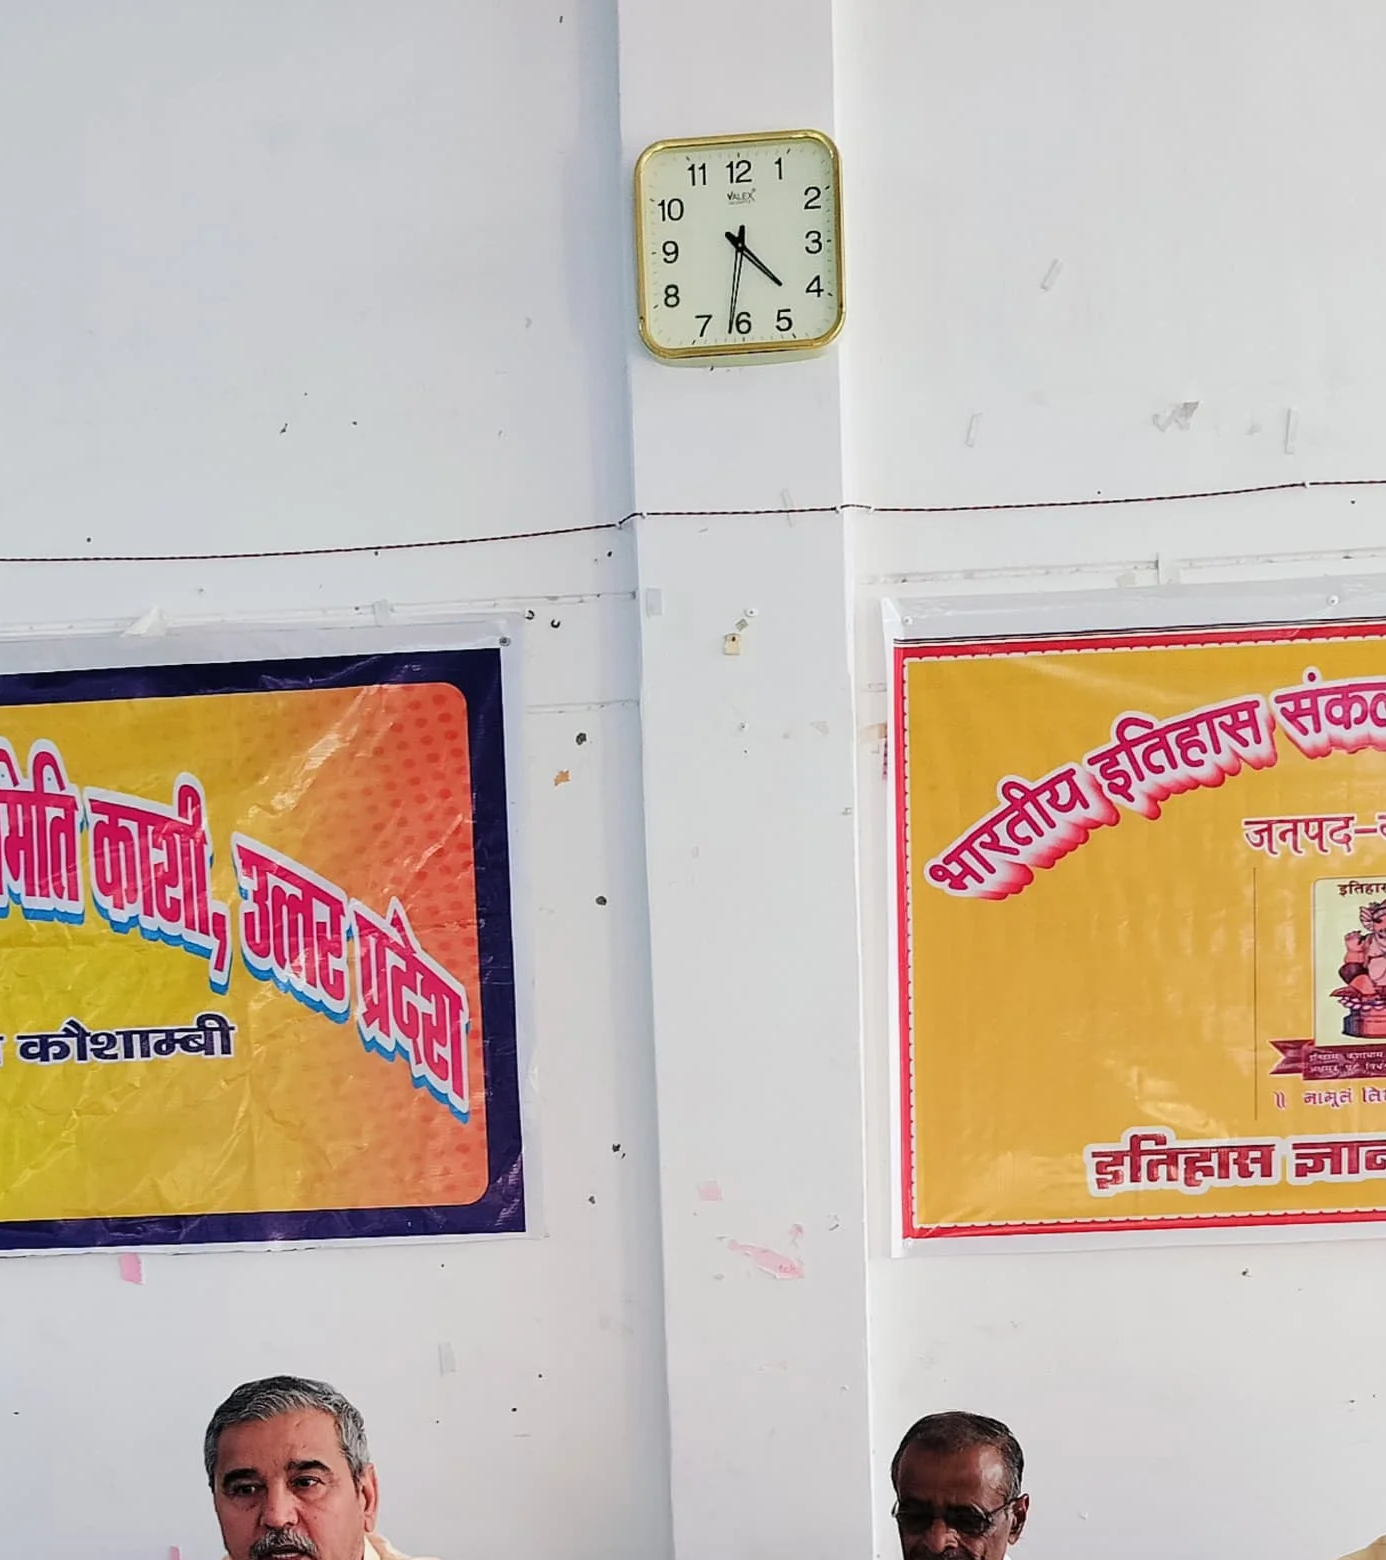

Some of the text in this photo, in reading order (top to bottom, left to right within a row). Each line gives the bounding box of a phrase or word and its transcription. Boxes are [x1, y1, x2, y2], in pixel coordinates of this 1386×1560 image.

[687, 163, 707, 186] 11
[726, 160, 752, 183] 12
[774, 157, 783, 180] 1
[804, 186, 822, 209] 2
[658, 198, 684, 221] 10
[662, 240, 679, 264] 9
[805, 231, 823, 254] 3
[663, 284, 680, 308] 8
[805, 275, 824, 298] 4
[695, 315, 713, 338] 7
[735, 312, 752, 334] 6
[775, 309, 793, 332] 5
[926, 765, 1093, 895] भारतीय
[1085, 697, 1264, 806] इतिहास
[87, 780, 230, 980] काशी,
[233, 838, 349, 1008] उत्तर
[352, 902, 468, 1107] प्रदेश
[15, 1012, 236, 1063] कौशाम्बी
[1089, 1132, 1277, 1191] इतिहास
